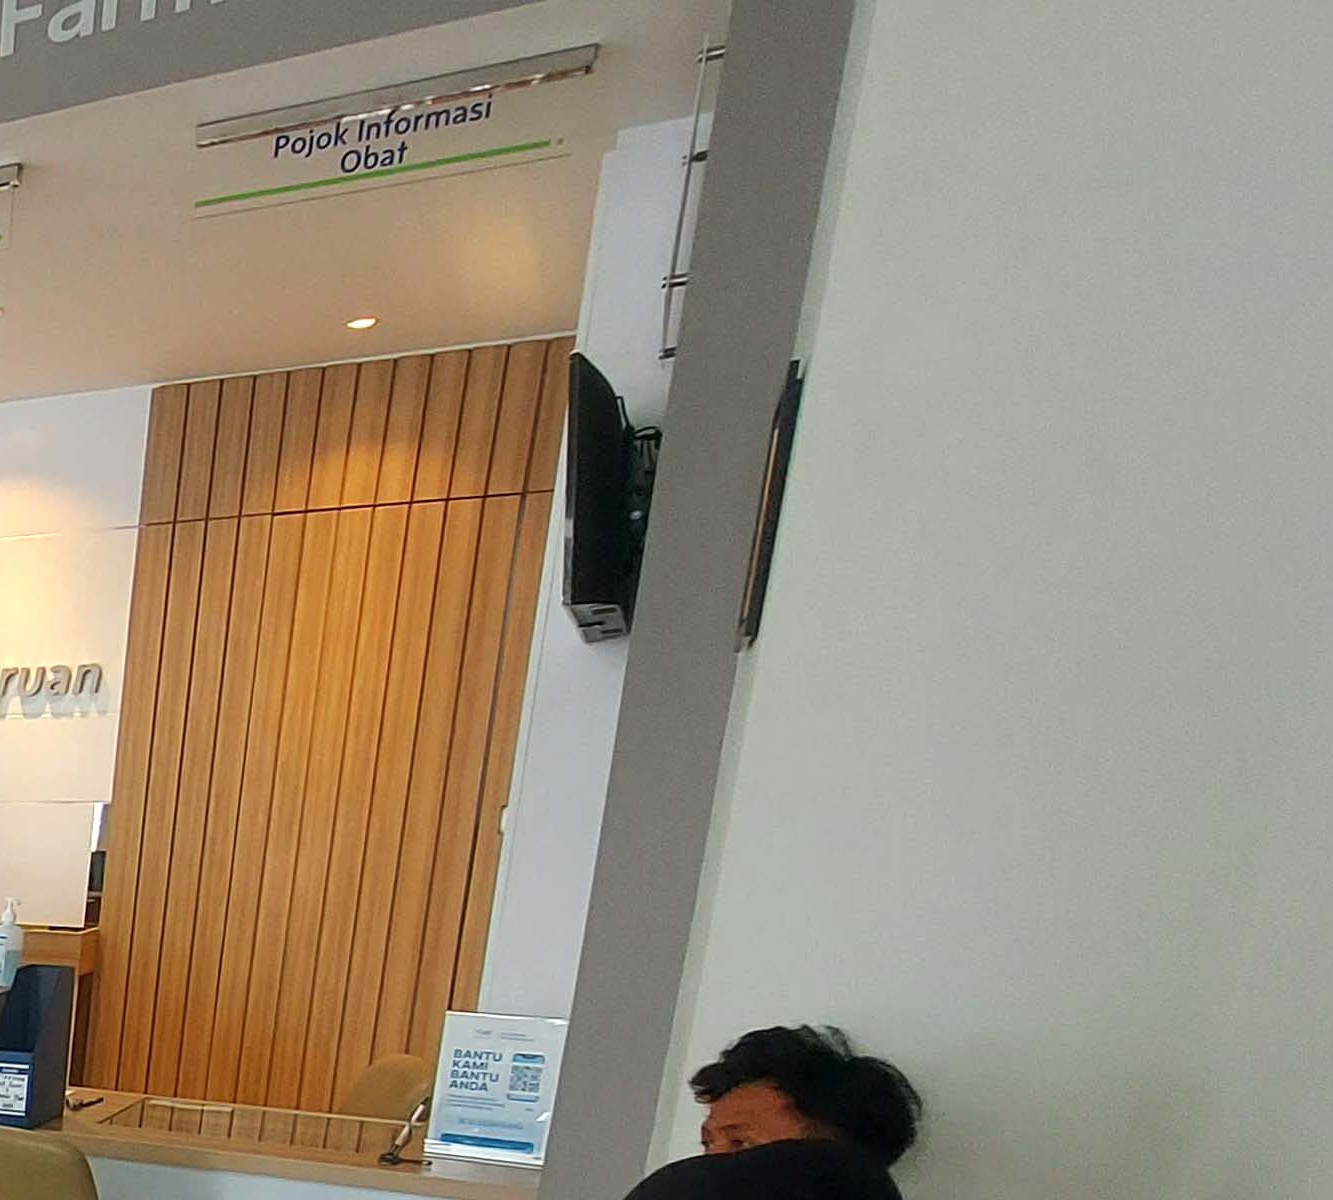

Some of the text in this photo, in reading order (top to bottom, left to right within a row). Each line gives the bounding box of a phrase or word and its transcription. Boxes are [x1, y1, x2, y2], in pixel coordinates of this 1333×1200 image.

[272, 94, 494, 159] Pojok Informasi
[339, 141, 409, 175] Obat
[454, 1049, 503, 1062] BANTU
[452, 1060, 488, 1071] KAMI
[450, 1069, 500, 1082] BANTU
[449, 1080, 488, 1092] ANDA
